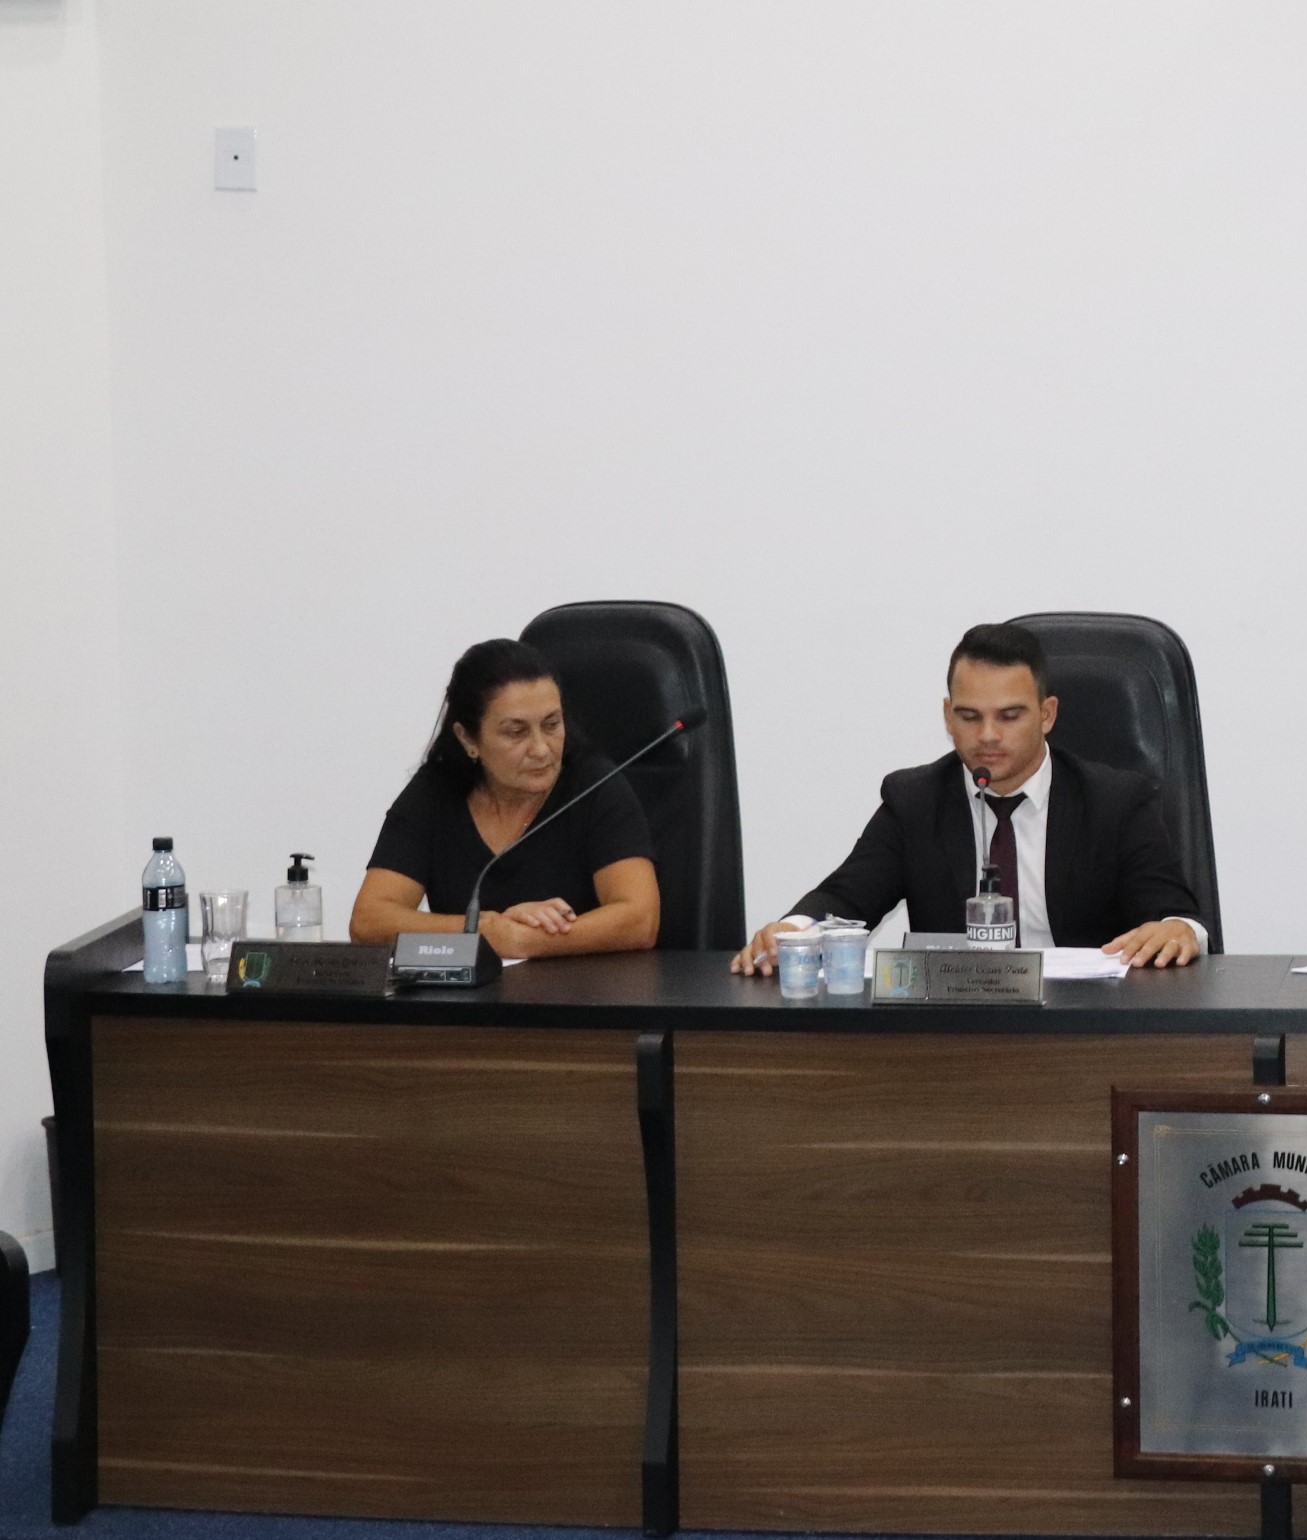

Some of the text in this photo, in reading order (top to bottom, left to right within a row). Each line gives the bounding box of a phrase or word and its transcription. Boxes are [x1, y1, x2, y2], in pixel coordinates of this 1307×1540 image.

[419, 945, 455, 955] Riole
[1200, 1152, 1260, 1188] CÂMARA
[1255, 1389, 1293, 1408] IRATI
